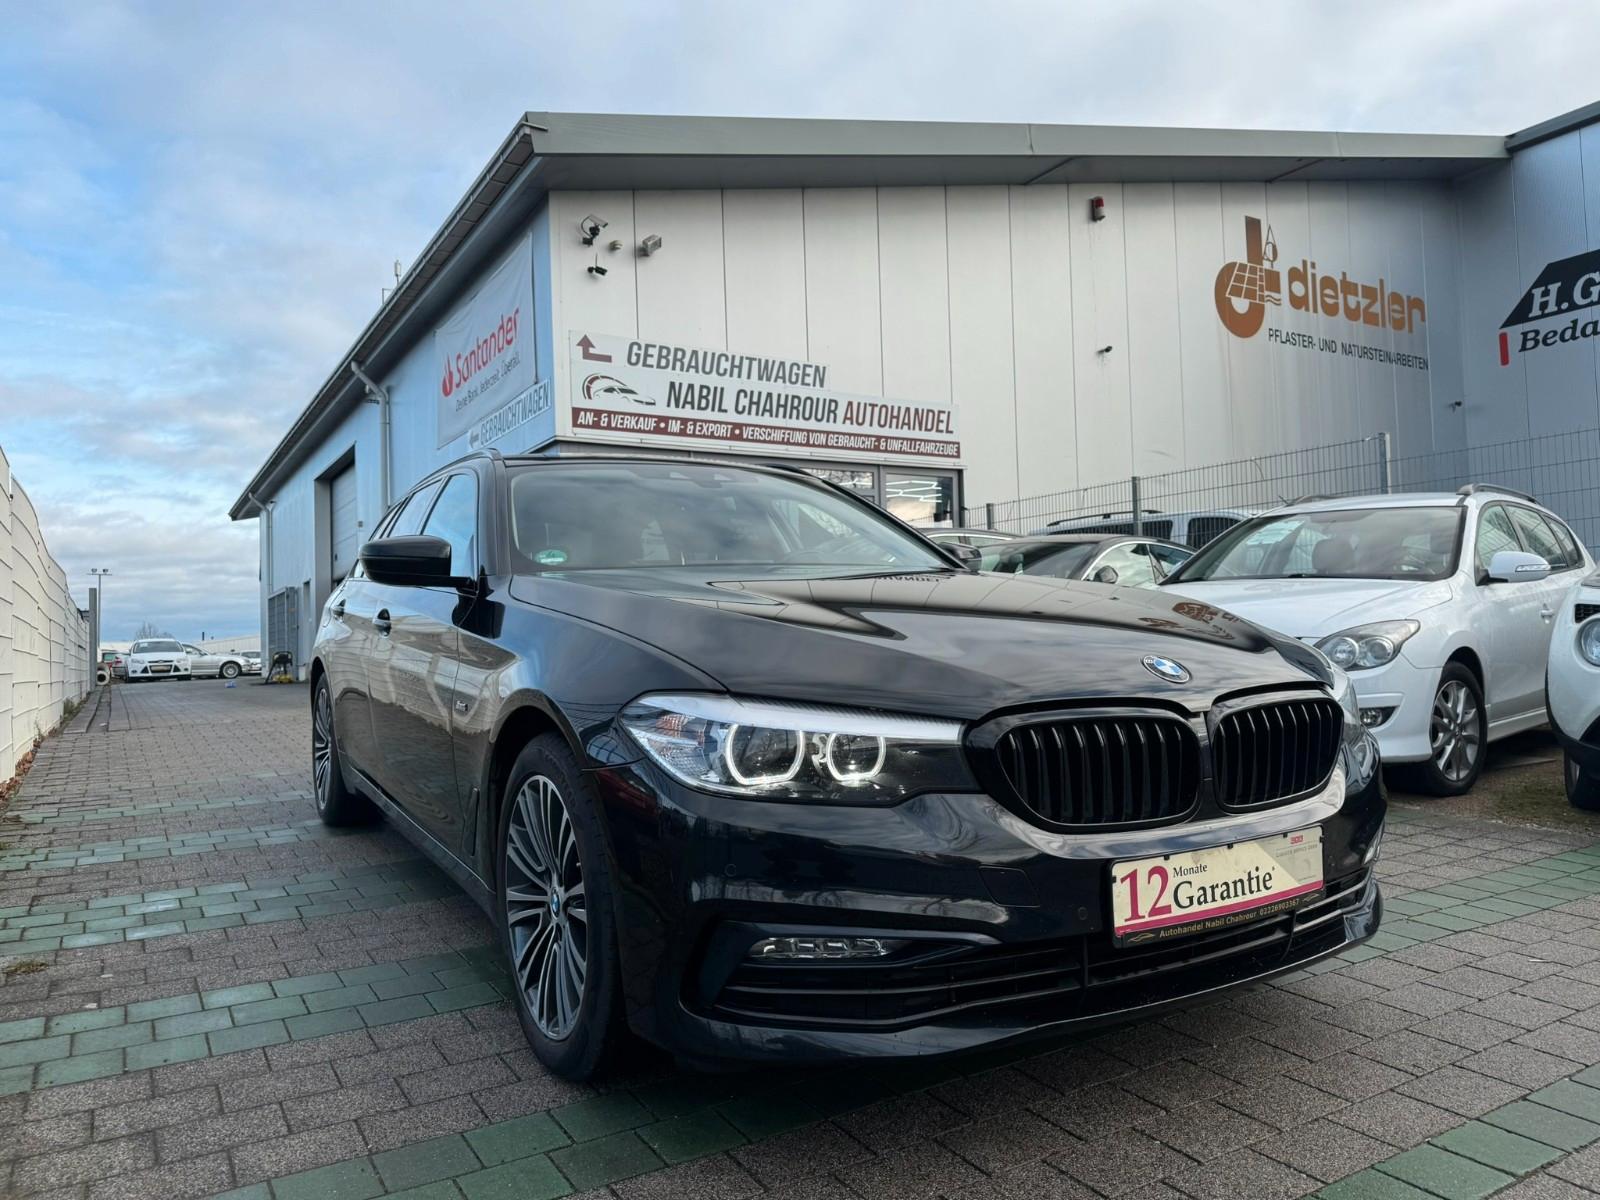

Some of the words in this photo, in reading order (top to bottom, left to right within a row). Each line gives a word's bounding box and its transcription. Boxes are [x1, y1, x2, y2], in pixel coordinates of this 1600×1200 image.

[1288, 259, 1426, 334] dietzler
[455, 307, 519, 389] Santander
[626, 341, 827, 388] GEBRAUCHTWAGEN
[1268, 328, 1316, 349] PFLASTER-
[1318, 336, 1337, 354] UND
[1341, 342, 1429, 371] NATURSTEINARBEITEN
[480, 385, 550, 446] GEBRAUCHTWAGEN
[577, 410, 598, 425] AN-
[600, 413, 607, 427] &
[610, 414, 658, 431] VERKAUF
[668, 419, 684, 433] IM-
[686, 421, 694, 434] &
[695, 422, 733, 438] EXPORT
[742, 426, 807, 444] VERSCHIFFUNG
[809, 431, 827, 446] VON
[828, 434, 878, 450] GEBRAUCHT-
[880, 438, 886, 450] &
[887, 440, 959, 456] UNFALLFAHRZEUGE
[666, 381, 728, 414] NABIL
[735, 388, 839, 424] CHAHROUR
[842, 401, 954, 434] AUTOHANDEL
[1120, 865, 1172, 922] 12
[1172, 863, 1208, 878] Monate
[1159, 922, 1204, 938] Autohandel
[1205, 918, 1225, 929] Nabil
[1226, 911, 1257, 925] Chahrour
